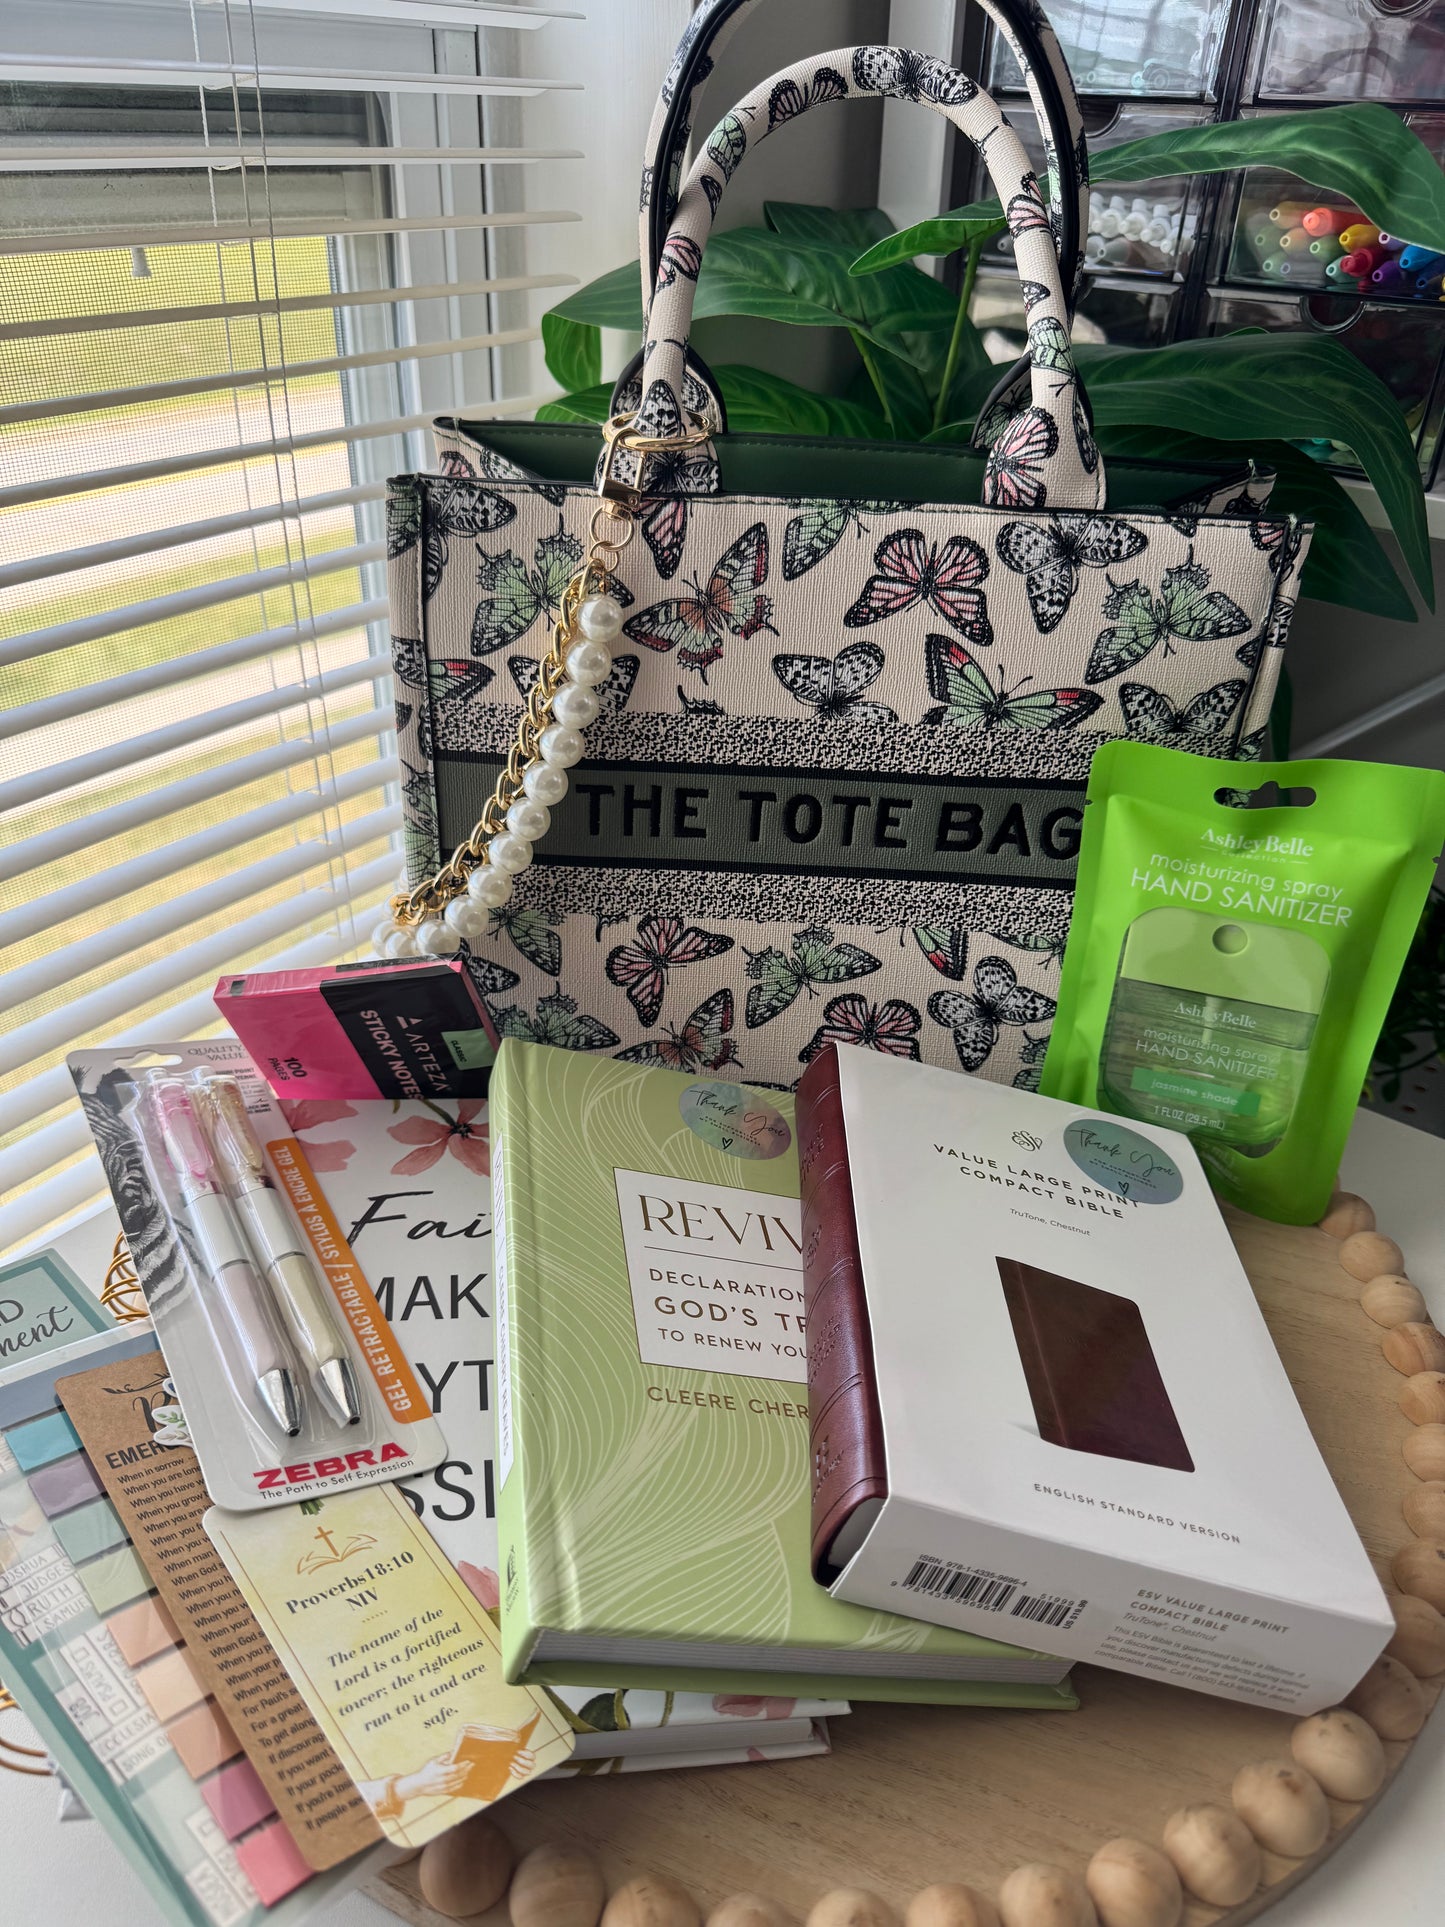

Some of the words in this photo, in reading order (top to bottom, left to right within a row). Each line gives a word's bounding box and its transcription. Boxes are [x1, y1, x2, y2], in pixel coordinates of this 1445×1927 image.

[576, 783, 709, 838] THE
[739, 790, 914, 849] TOTE
[935, 802, 1084, 860] BAG
[1150, 853, 1276, 892] moisturizing
[1283, 879, 1343, 902] spray
[1131, 868, 1213, 903] HAND
[1219, 886, 1353, 928] SANITIZER
[360, 1009, 395, 1059] STICKY
[388, 1056, 424, 1100] NOTES
[450, 1040, 467, 1063] CLASSIC
[1144, 1028, 1230, 1055] moisturizing
[268, 1057, 290, 1081] PAGES
[283, 1056, 307, 1078] 100
[1135, 1040, 1189, 1060] HAND
[1193, 1052, 1279, 1080] SANITIZER
[1151, 1079, 1198, 1097] jasmine
[1201, 1091, 1239, 1106] shade
[689, 1089, 738, 1116] Thank
[743, 1112, 785, 1137] You
[274, 1145, 295, 1166] GEL
[282, 1166, 314, 1203] ENCRE
[934, 1144, 998, 1169] VALUE
[1007, 1164, 1072, 1191] LARGE
[1082, 1186, 1139, 1208] PRINT
[960, 1166, 1054, 1199] COMPACT
[1065, 1195, 1124, 1219] BIBLE
[306, 1215, 340, 1259] STYLOS
[1010, 1208, 1048, 1225] TruTone,
[1050, 1220, 1091, 1236] Chestnut
[333, 1272, 395, 1378] RETRACTABLE
[654, 1296, 758, 1327] GOD'S
[658, 1328, 685, 1342] TO
[695, 1333, 763, 1353] RENEW
[385, 1378, 412, 1412] GEL
[647, 1387, 737, 1411] CLEERE
[105, 1439, 178, 1469] EMER
[253, 1442, 409, 1489] ZEBRA
[117, 1471, 144, 1484] When
[145, 1467, 154, 1475] in
[154, 1458, 184, 1472] sorrow
[123, 1482, 150, 1496] When
[151, 1477, 167, 1488] you
[168, 1472, 183, 1480] are
[260, 1490, 283, 1499] The
[286, 1482, 313, 1495] Path
[316, 1480, 328, 1488] to
[330, 1473, 352, 1485] Self
[357, 1459, 414, 1479] Expression
[130, 1494, 157, 1508] When
[157, 1489, 173, 1500] you
[174, 1481, 195, 1493] have
[136, 1506, 164, 1520] When
[164, 1501, 180, 1513] you
[181, 1493, 203, 1507] grow
[143, 1519, 171, 1534] When
[171, 1514, 188, 1526] you
[188, 1509, 204, 1518] are
[1034, 1483, 1095, 1506] ENGLISH
[1100, 1500, 1174, 1527] STANDARD
[1179, 1521, 1241, 1544] VERSION
[164, 1558, 192, 1573] When
[192, 1550, 214, 1563] man
[918, 1554, 942, 1565] ISBN
[20, 1561, 73, 1597] JUDGES
[171, 1571, 199, 1586] When
[199, 1564, 218, 1576] God
[28, 1583, 73, 1618] RUTH
[344, 1586, 380, 1611] NIV
[1040, 1593, 1075, 1608] 51999
[1137, 1589, 1162, 1600] ESV
[1166, 1596, 1206, 1612] VALUE
[1208, 1607, 1250, 1624] LARGE
[1251, 1619, 1289, 1634] PRINT
[1062, 1620, 1074, 1630] US
[1130, 1601, 1190, 1621] COMPACT
[1192, 1617, 1229, 1632] BIBLE
[328, 1649, 357, 1668] The
[361, 1629, 400, 1654] name
[404, 1616, 419, 1633] of
[421, 1608, 443, 1625] the
[1171, 1625, 1217, 1641] Chestnut
[334, 1666, 371, 1691] Lord
[373, 1659, 388, 1673] is
[390, 1653, 401, 1664] a
[404, 1622, 462, 1662] fortified
[338, 1687, 388, 1717] tower;
[391, 1672, 415, 1691] the
[419, 1638, 484, 1675] righteous
[242, 1706, 259, 1717] For
[363, 1713, 392, 1732] run
[396, 1701, 411, 1716] to
[413, 1692, 426, 1706] it
[430, 1675, 458, 1699] and
[461, 1663, 487, 1682] are
[250, 1721, 268, 1732] For
[277, 1703, 303, 1722] great
[423, 1704, 459, 1729] safe.
[258, 1737, 273, 1748] To
[273, 1729, 289, 1744] get
[290, 1717, 317, 1735] along
